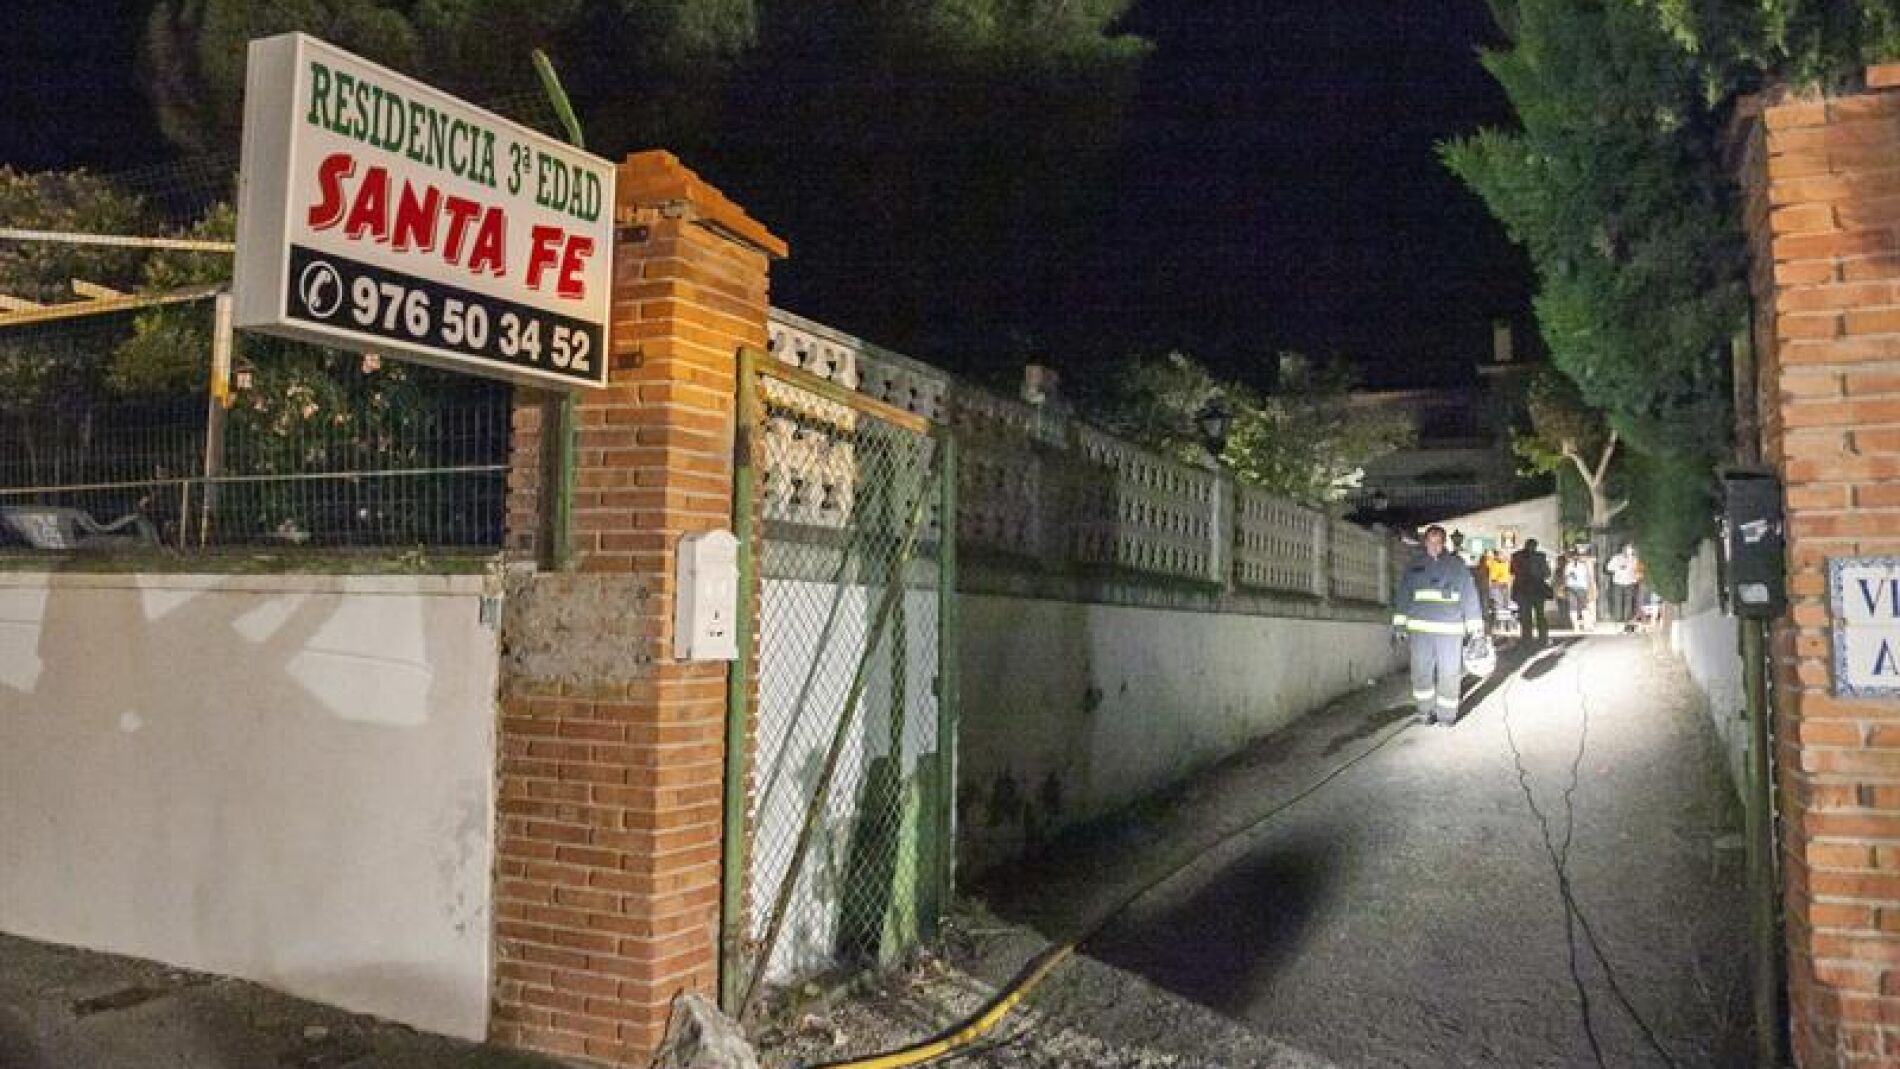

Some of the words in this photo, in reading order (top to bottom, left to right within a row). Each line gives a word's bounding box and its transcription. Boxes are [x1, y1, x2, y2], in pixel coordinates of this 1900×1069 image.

[306, 61, 498, 188] RESIDENCIA
[507, 142, 531, 195] 3ª
[536, 152, 601, 222] EDAD
[307, 153, 507, 277] SANTA
[525, 225, 595, 299] FE
[351, 277, 431, 336] 976
[441, 299, 489, 349] 50
[500, 313, 542, 360] 34
[550, 328, 591, 371] 52
